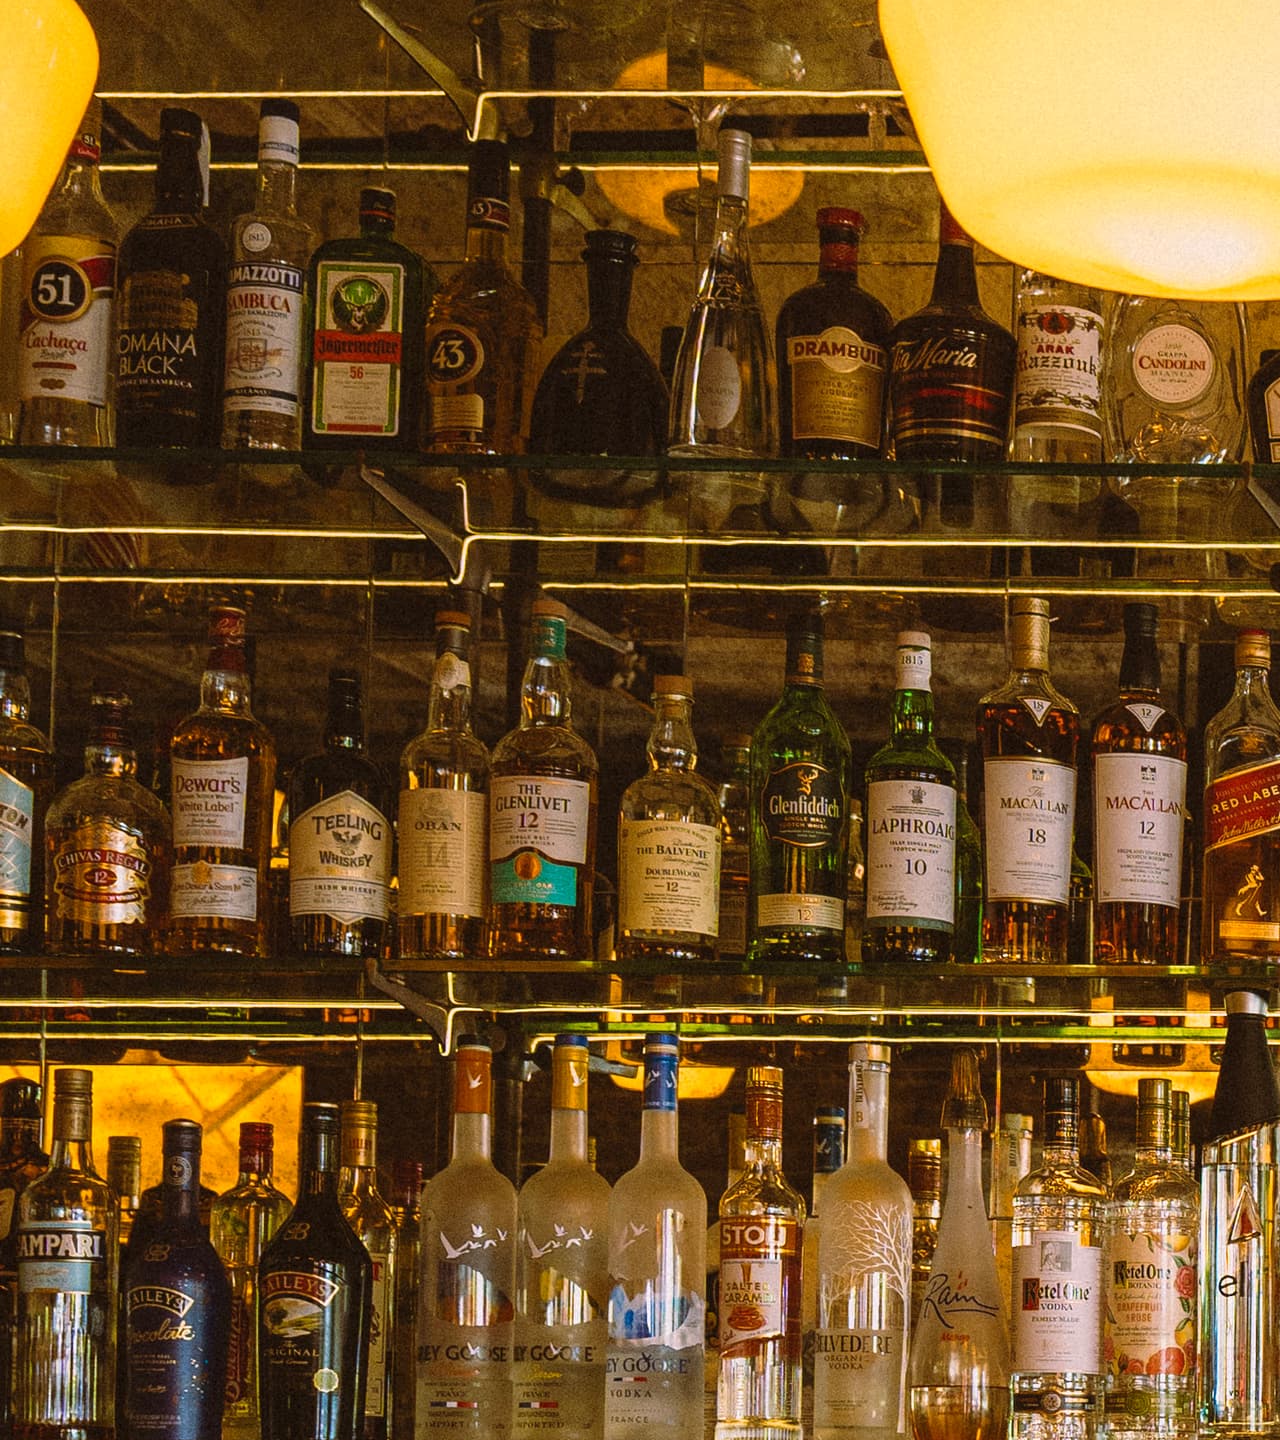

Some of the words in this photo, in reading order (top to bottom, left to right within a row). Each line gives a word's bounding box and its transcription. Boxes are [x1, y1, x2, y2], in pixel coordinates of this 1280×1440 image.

[37, 273, 75, 306] 51
[228, 292, 290, 313] SAMBUCA
[25, 331, 88, 354] Cachaça
[1036, 344, 1075, 356] ARAK
[432, 339, 465, 369] 43
[912, 337, 979, 370] Maria
[1158, 351, 1188, 359] GRAPPA
[119, 356, 177, 376] BLACK
[1138, 355, 1206, 371] CANDOLINI
[350, 366, 364, 379] 56
[1032, 700, 1045, 711] 18
[1140, 708, 1153, 717] 12
[175, 775, 241, 794] Dewar's
[518, 784, 542, 796] THE
[204, 801, 234, 813] Label
[496, 797, 571, 814] GLENLIVET
[769, 795, 840, 818] Glenfiddich
[1000, 798, 1069, 816] MACALLAN
[1105, 796, 1183, 816] MACALLAN
[1211, 799, 1240, 815] RED
[312, 814, 382, 840] TEELING
[414, 821, 462, 832] OBAN
[518, 812, 539, 828] 12
[872, 819, 956, 841] LAPHROAIG
[1027, 827, 1047, 844] 18
[1138, 821, 1156, 836] 12
[319, 850, 373, 867] WHISKEY
[636, 847, 653, 856] THE
[656, 845, 709, 859] BALVENIE
[57, 850, 102, 869] CHIVAS
[105, 850, 149, 874] REGAL
[904, 859, 928, 876] 10
[94, 871, 109, 884] 12
[340, 885, 377, 894] WHISKEY
[666, 882, 679, 892] 12
[797, 909, 813, 921] 12
[18, 1233, 103, 1259] AMPARI
[1114, 1260, 1145, 1286] Ketel
[1146, 1263, 1171, 1279] One
[1023, 1278, 1059, 1306] Ketel
[1062, 1283, 1090, 1302] One
[1040, 1303, 1073, 1311] VODKA
[446, 1345, 508, 1361] GOOSE
[828, 1362, 864, 1370] VODKA
[609, 1389, 653, 1398] VODKA
[610, 1415, 650, 1424] FRANCE
